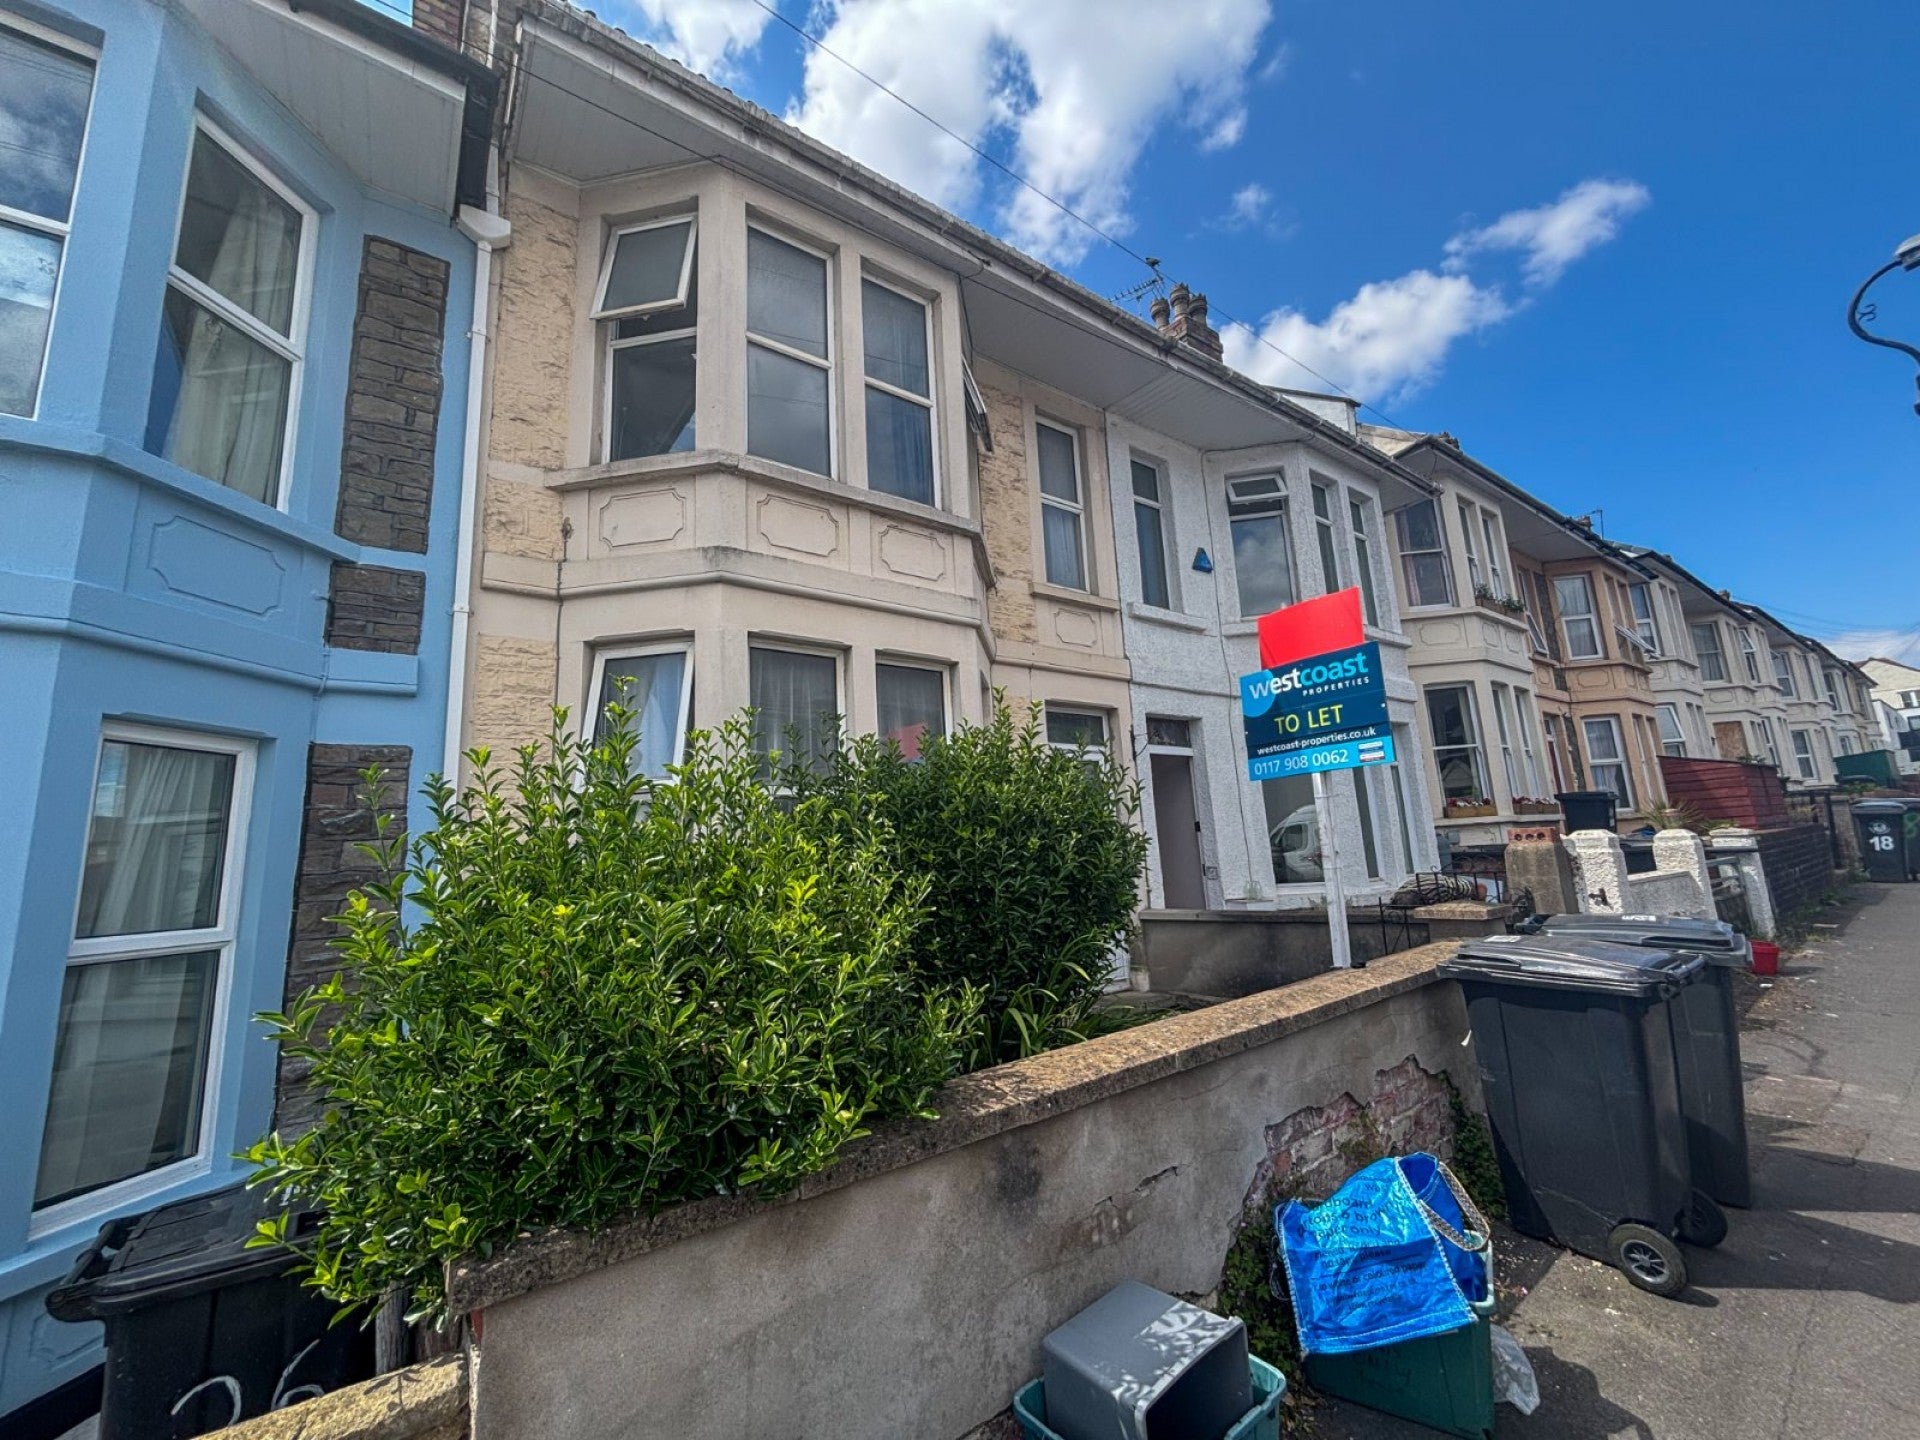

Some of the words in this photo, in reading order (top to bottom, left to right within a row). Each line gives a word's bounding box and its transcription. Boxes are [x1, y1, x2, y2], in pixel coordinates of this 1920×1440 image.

[1249, 652, 1368, 699] westcoast
[1303, 676, 1369, 696] PROPERTIES
[1274, 713, 1300, 734] TO
[1308, 704, 1343, 728] LET
[1257, 727, 1376, 755] westcoast-properties.co.uk
[1254, 760, 1280, 775] 0117
[1284, 756, 1308, 771] 908
[1312, 750, 1348, 766] 0062
[1869, 836, 1894, 851] 18
